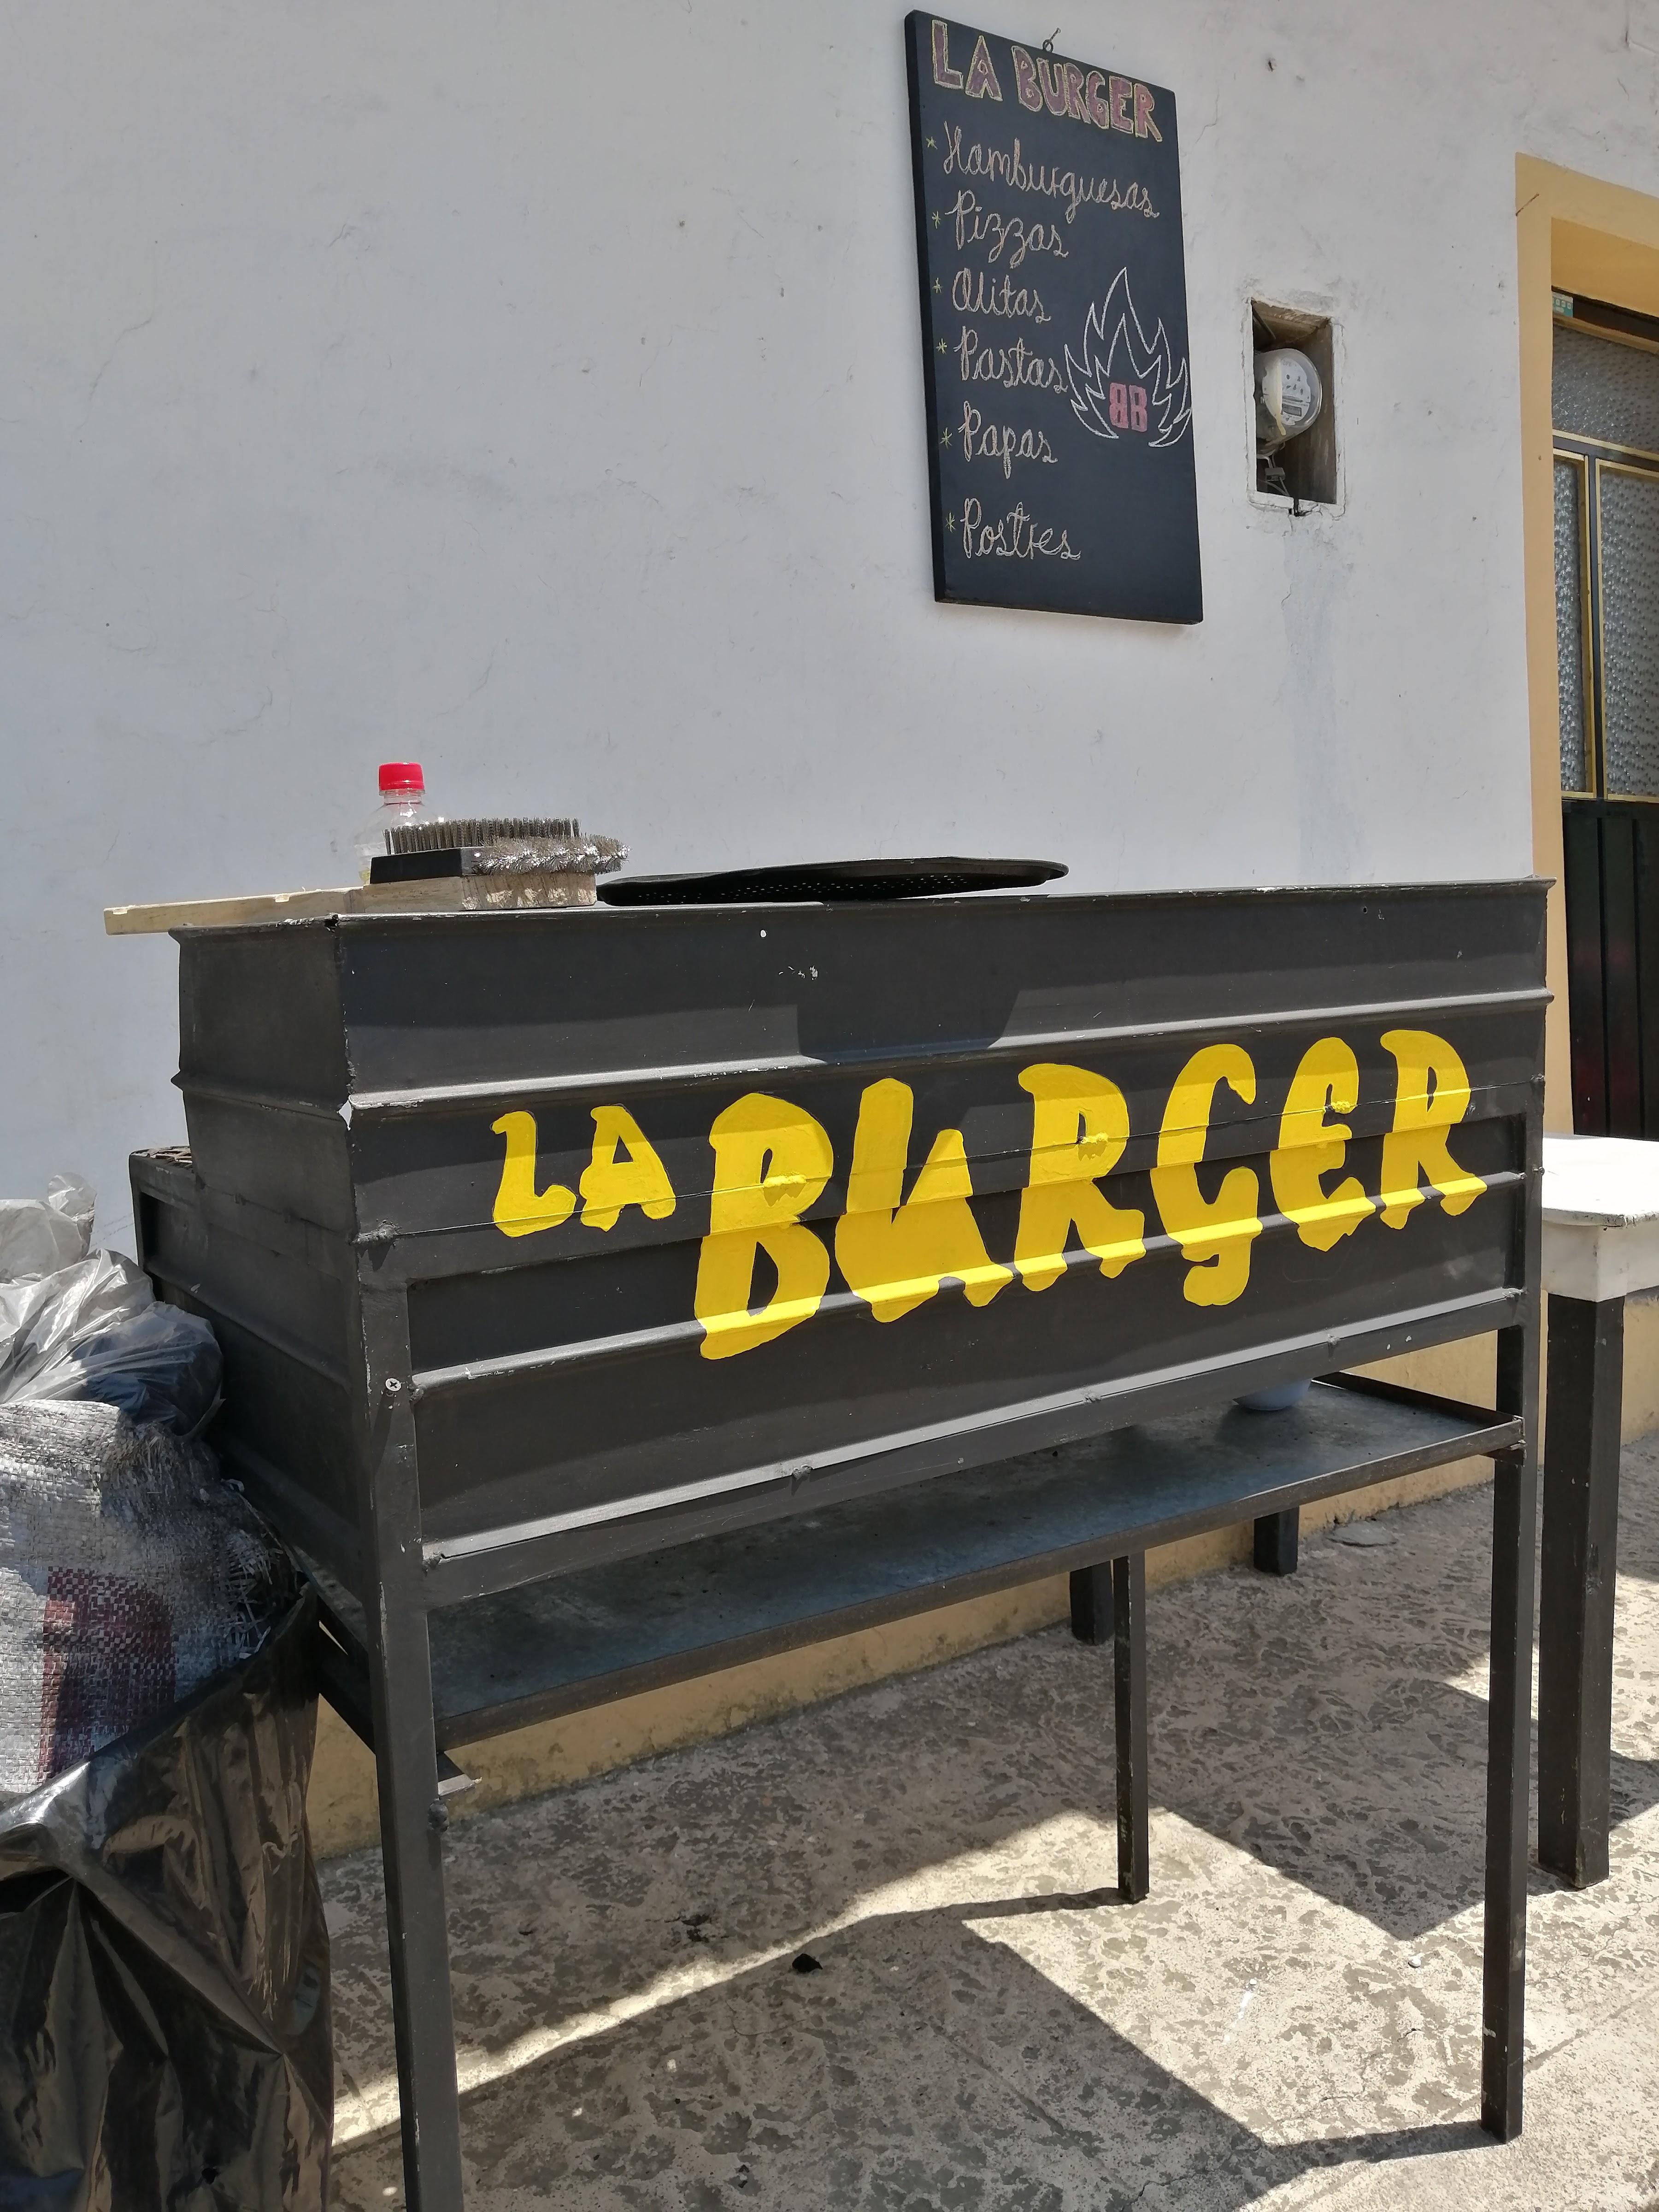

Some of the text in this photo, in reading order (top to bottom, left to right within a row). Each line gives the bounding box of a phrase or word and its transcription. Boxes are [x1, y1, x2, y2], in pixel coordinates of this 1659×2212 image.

[932, 20, 1162, 142] LA BURGER
[943, 121, 1160, 224] Hamburguesas
[945, 189, 1068, 269] Pizzas
[952, 267, 1051, 323] Alitas
[953, 326, 1068, 394] Pastas
[958, 400, 1058, 479] Papas
[960, 497, 1081, 560] Postres
[492, 1029, 1488, 1359] LA BURGER
